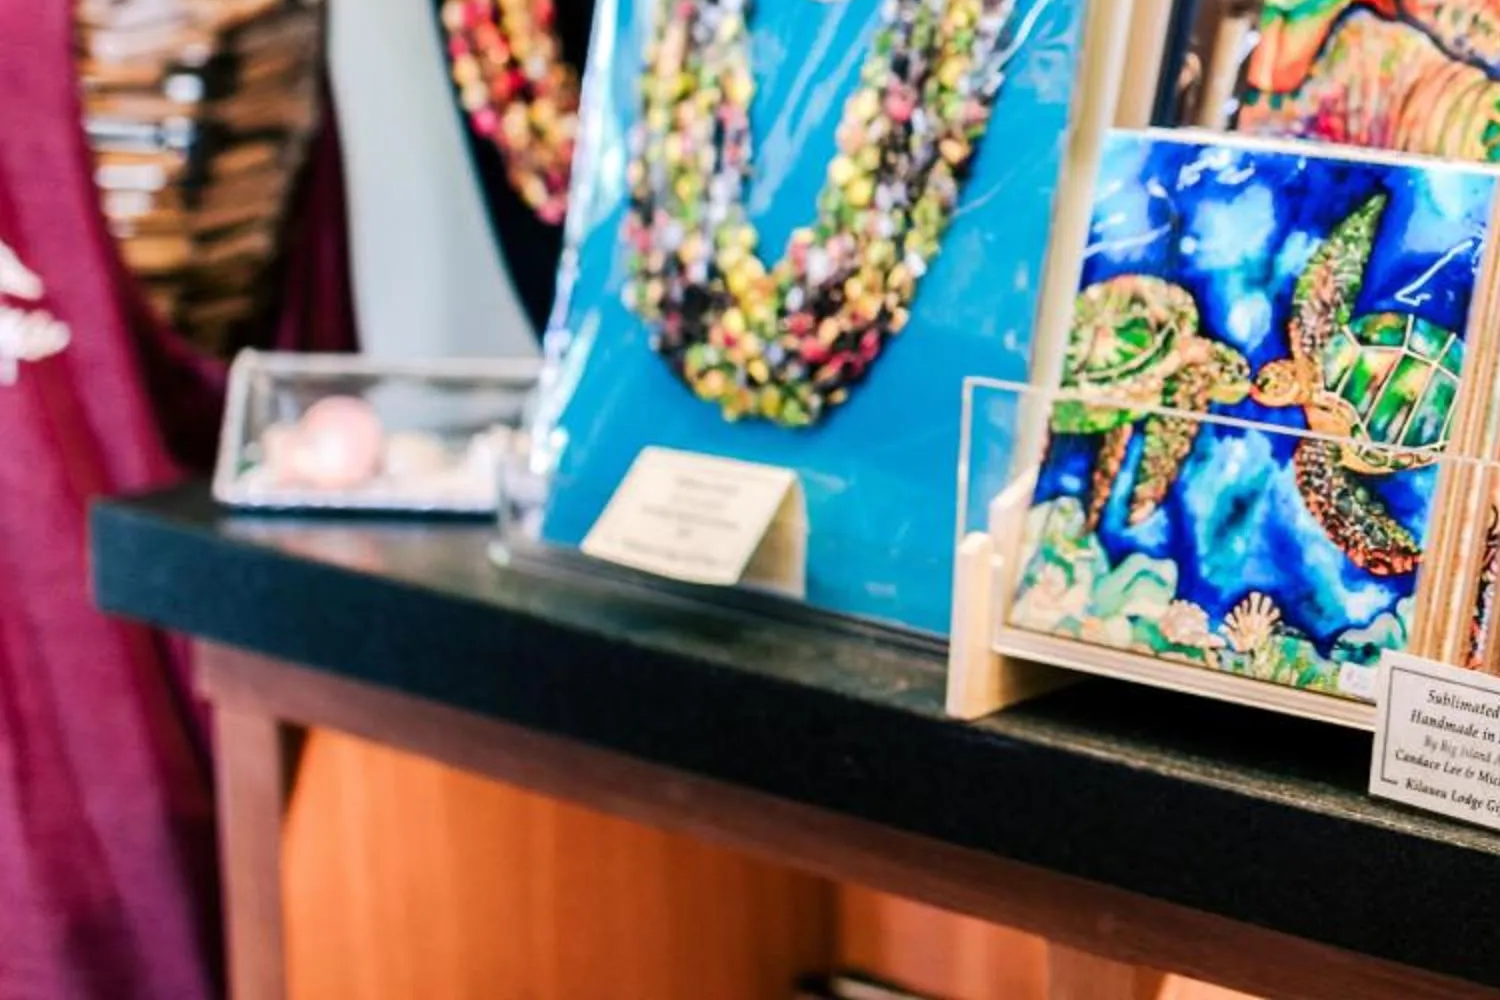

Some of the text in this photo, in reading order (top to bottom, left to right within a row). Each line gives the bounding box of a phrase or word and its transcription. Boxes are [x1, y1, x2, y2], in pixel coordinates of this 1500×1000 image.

[1427, 690, 1500, 719] Sublimated
[1411, 709, 1479, 739] Handmade
[1483, 728, 1495, 744] in
[1423, 735, 1437, 750] By
[1440, 738, 1458, 755] Big
[1460, 745, 1491, 761] Island
[1395, 750, 1440, 770] Candace
[1443, 759, 1463, 776] Lee
[1465, 767, 1475, 778] &
[1452, 790, 1483, 809] Lodge
